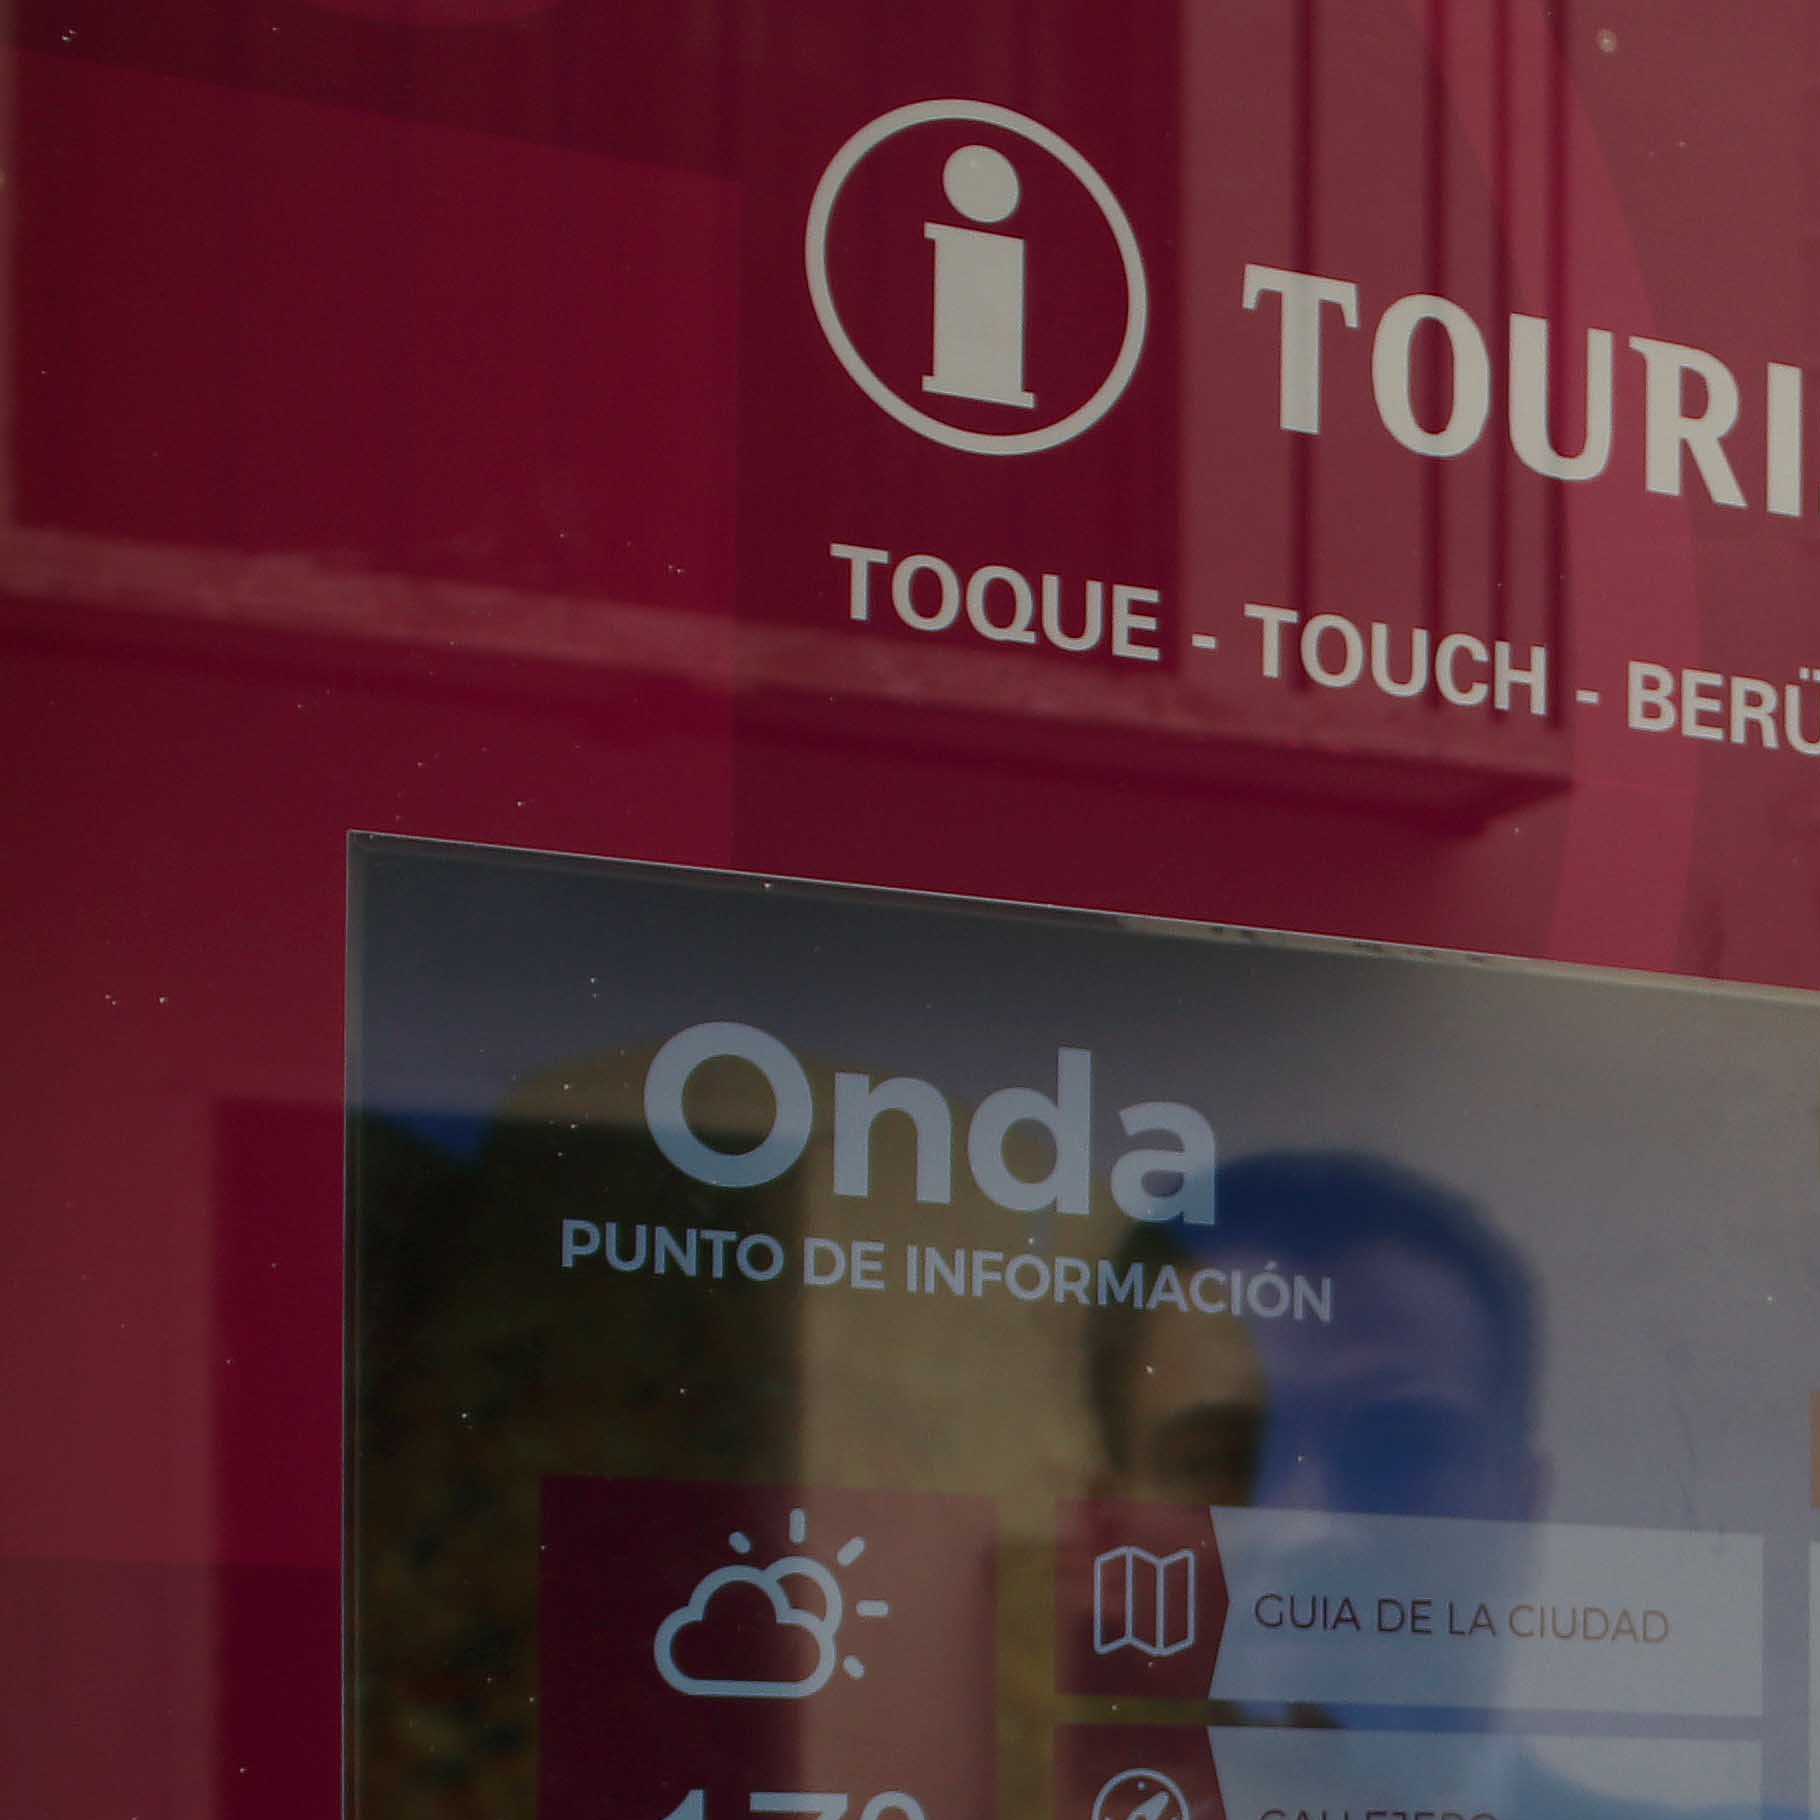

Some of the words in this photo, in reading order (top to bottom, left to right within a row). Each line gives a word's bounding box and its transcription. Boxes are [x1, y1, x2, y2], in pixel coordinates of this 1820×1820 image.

[830, 543, 1160, 662] TOQUE
[1243, 602, 1548, 716] TOUCH
[643, 1020, 1217, 1226] Onda
[561, 1218, 785, 1283] PUNTO
[803, 1239, 886, 1291] DE
[905, 1245, 1334, 1323] INFORMACIÓN
[1253, 1593, 1361, 1631] GUIA
[1376, 1599, 1432, 1635] DE
[1447, 1603, 1496, 1638] LA
[1508, 1604, 1671, 1644] CIUDAD
